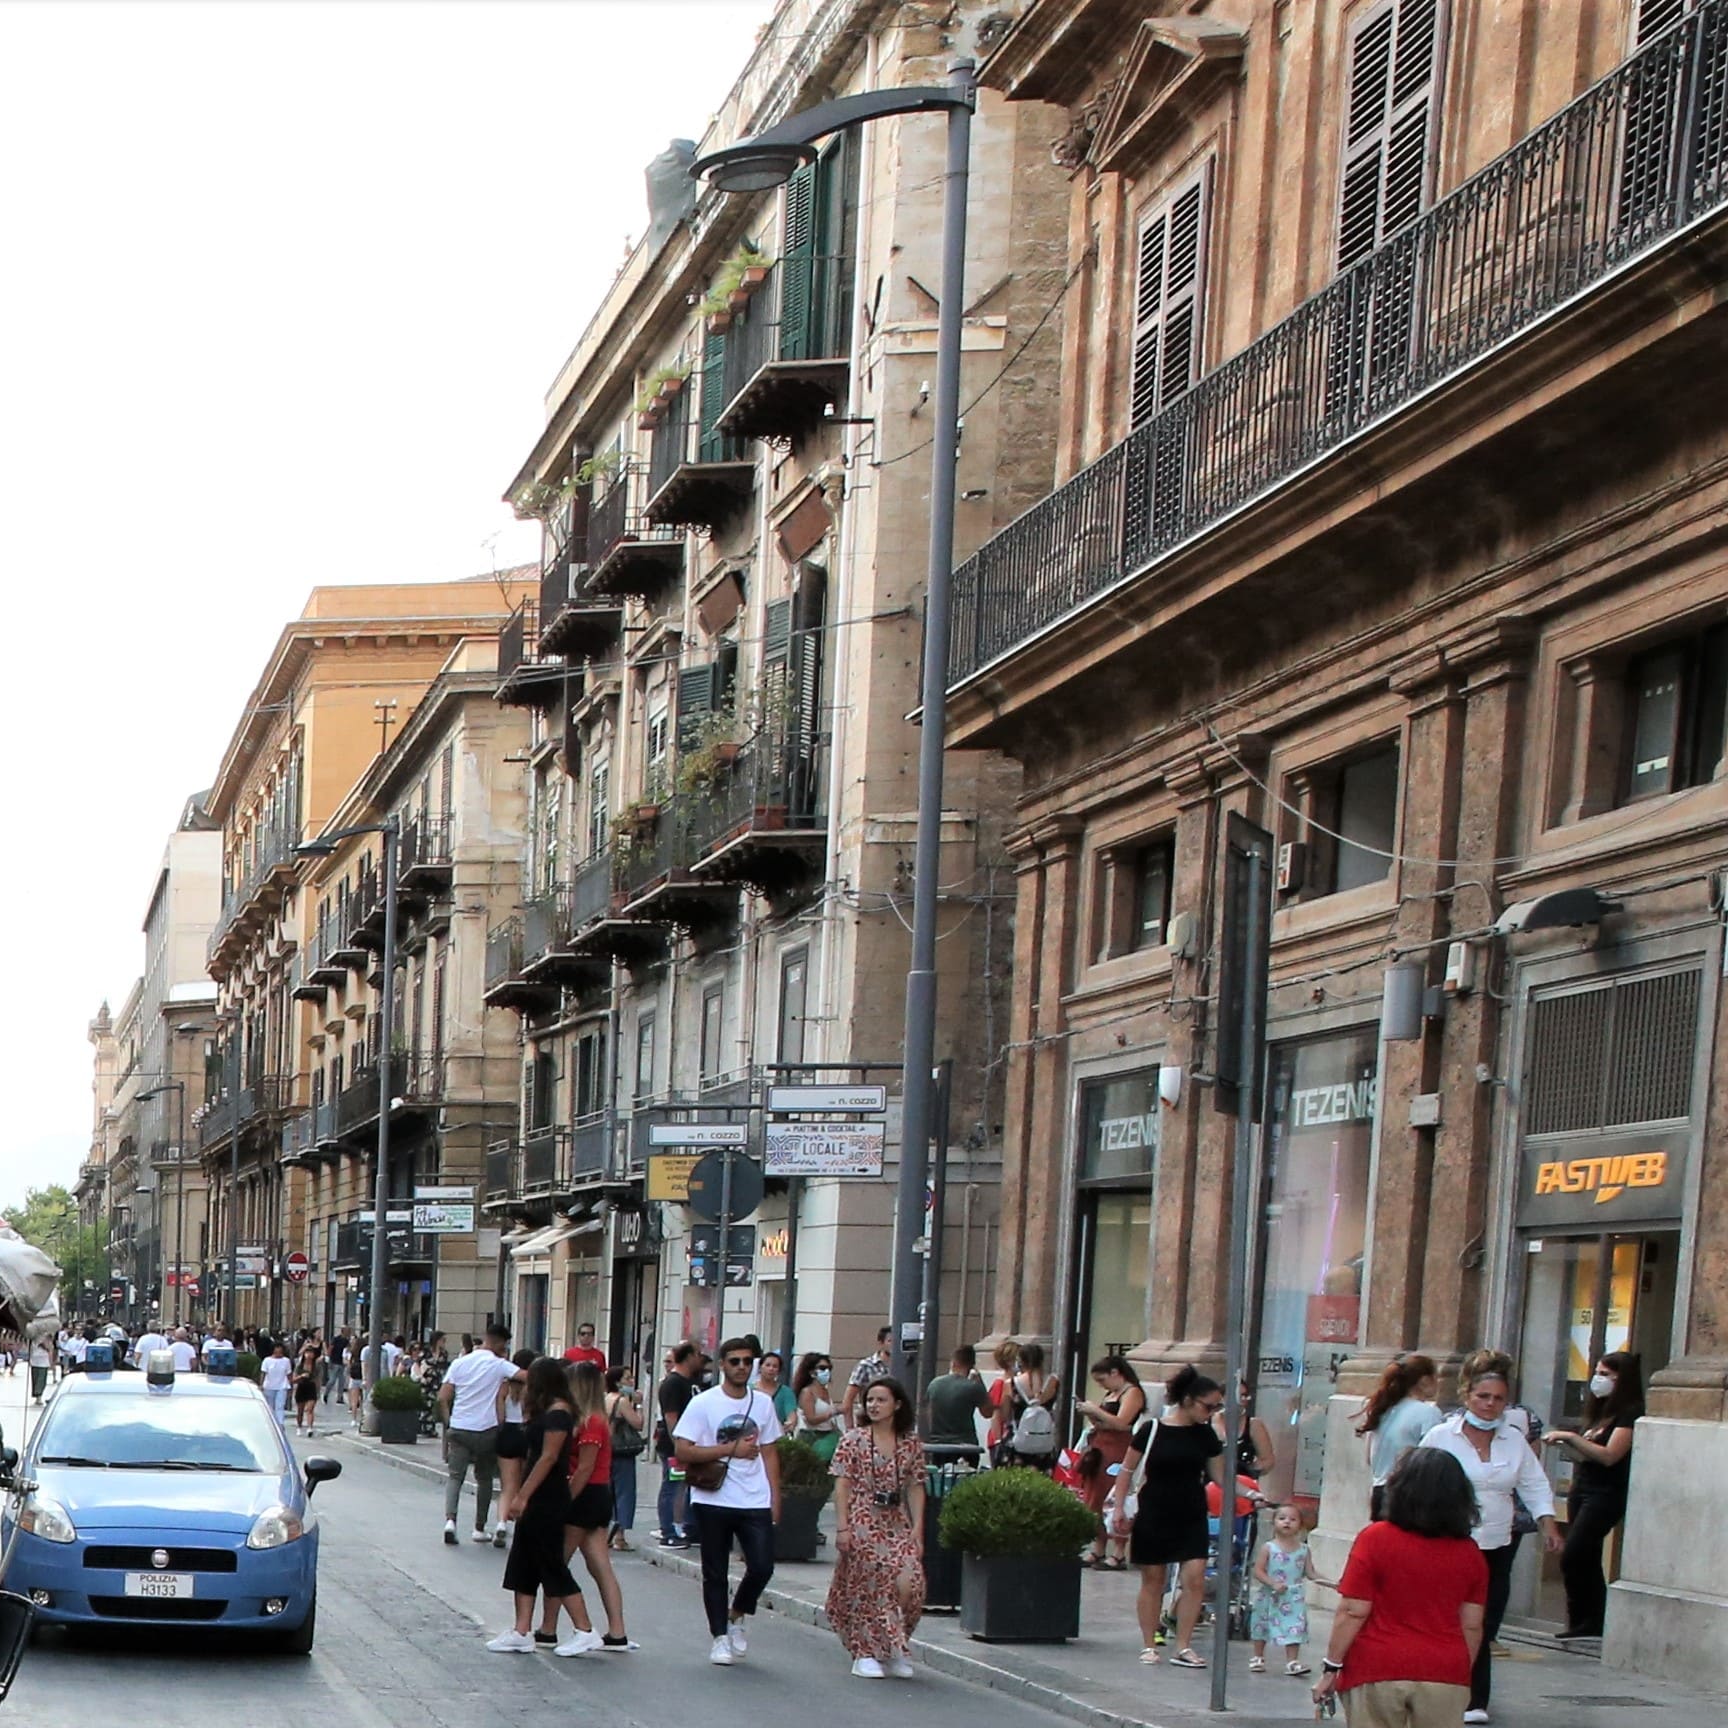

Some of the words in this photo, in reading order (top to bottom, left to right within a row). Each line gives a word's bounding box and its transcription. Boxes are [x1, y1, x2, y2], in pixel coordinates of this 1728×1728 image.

[803, 1143, 846, 1156] LOCALE
[1535, 1152, 1667, 1204] FASTWEB
[140, 1574, 178, 1583] POLIZIA
[141, 1584, 177, 1596] H3133
